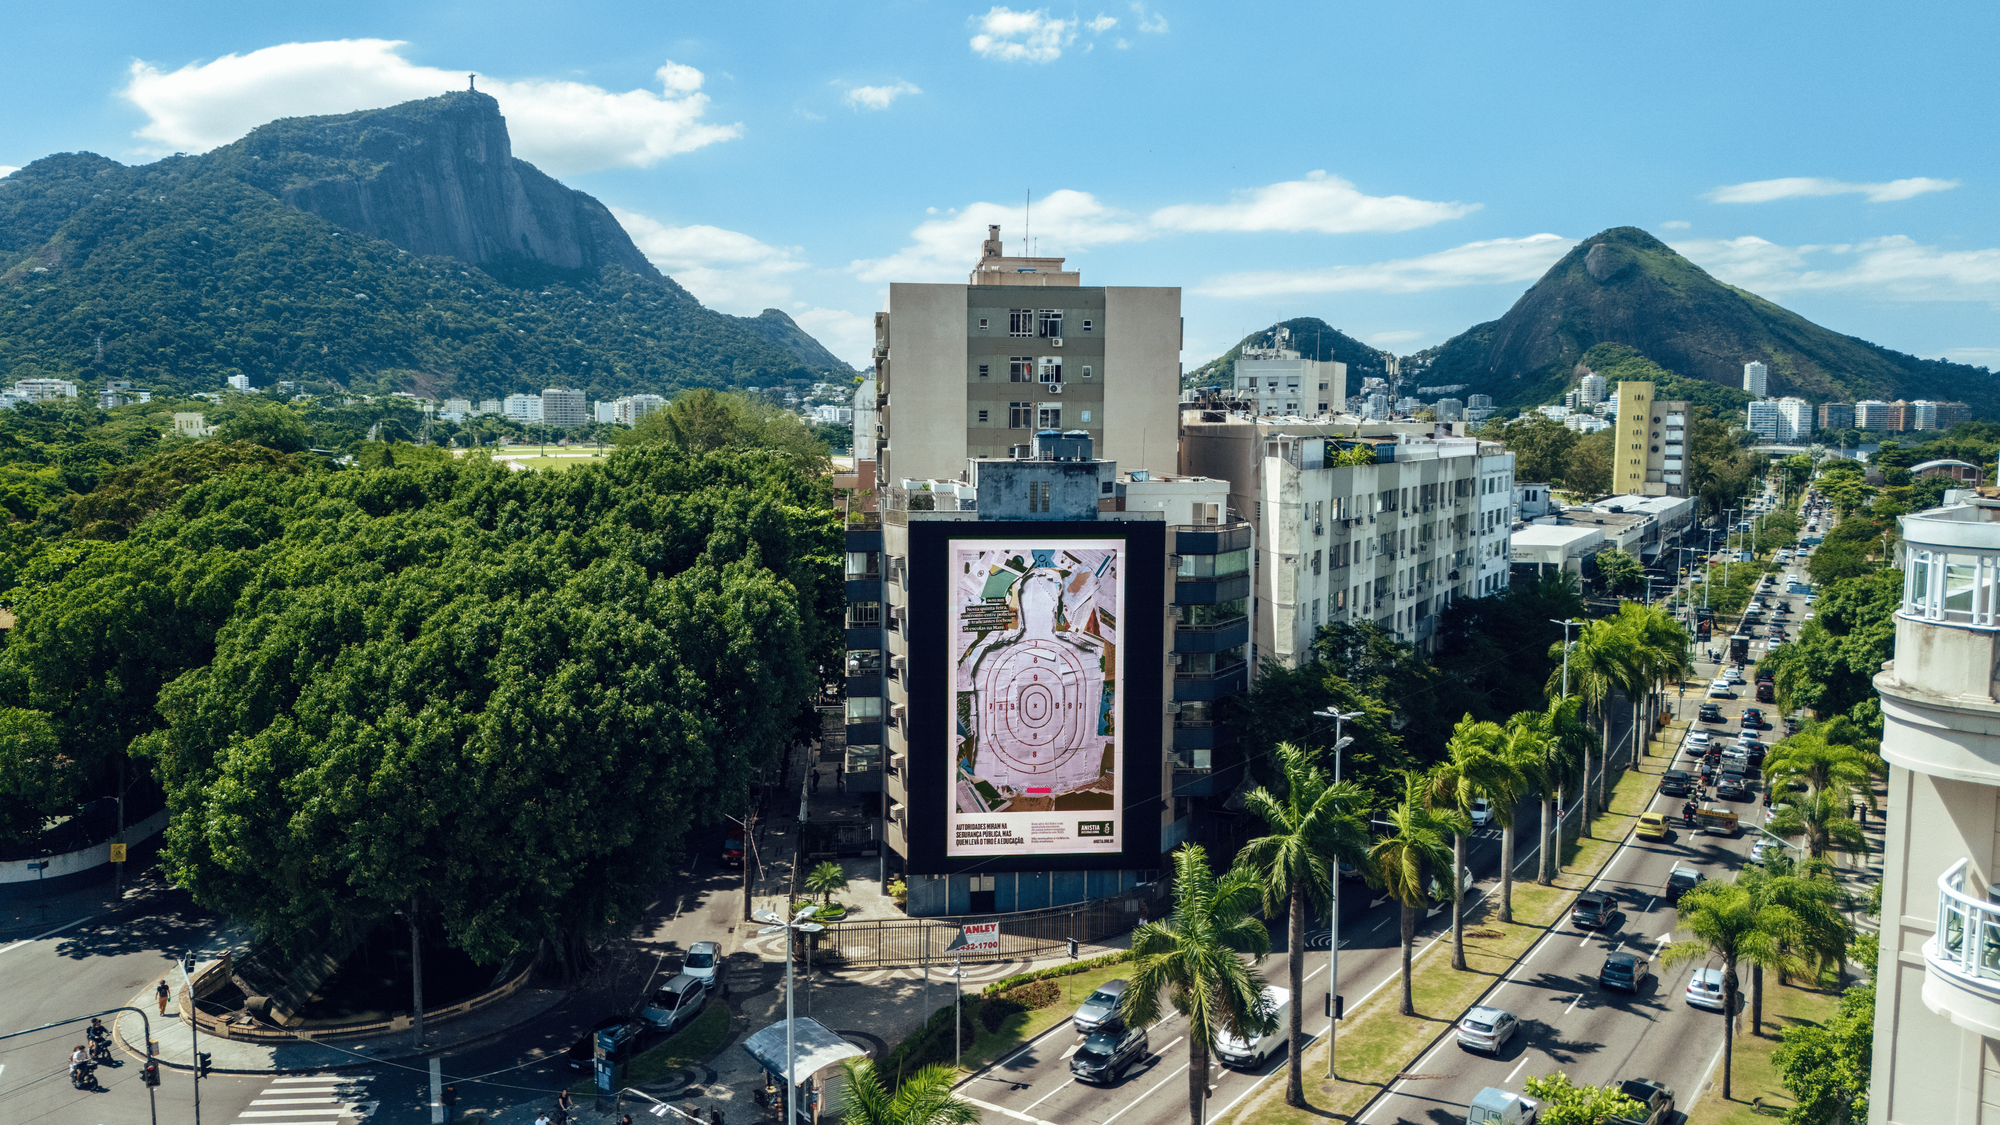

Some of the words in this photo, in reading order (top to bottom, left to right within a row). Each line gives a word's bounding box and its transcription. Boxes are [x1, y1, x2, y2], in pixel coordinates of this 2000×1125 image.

[956, 831, 982, 839] SEGURANÇA
[956, 838, 968, 847] QUEM
[963, 924, 996, 934] ANLEY
